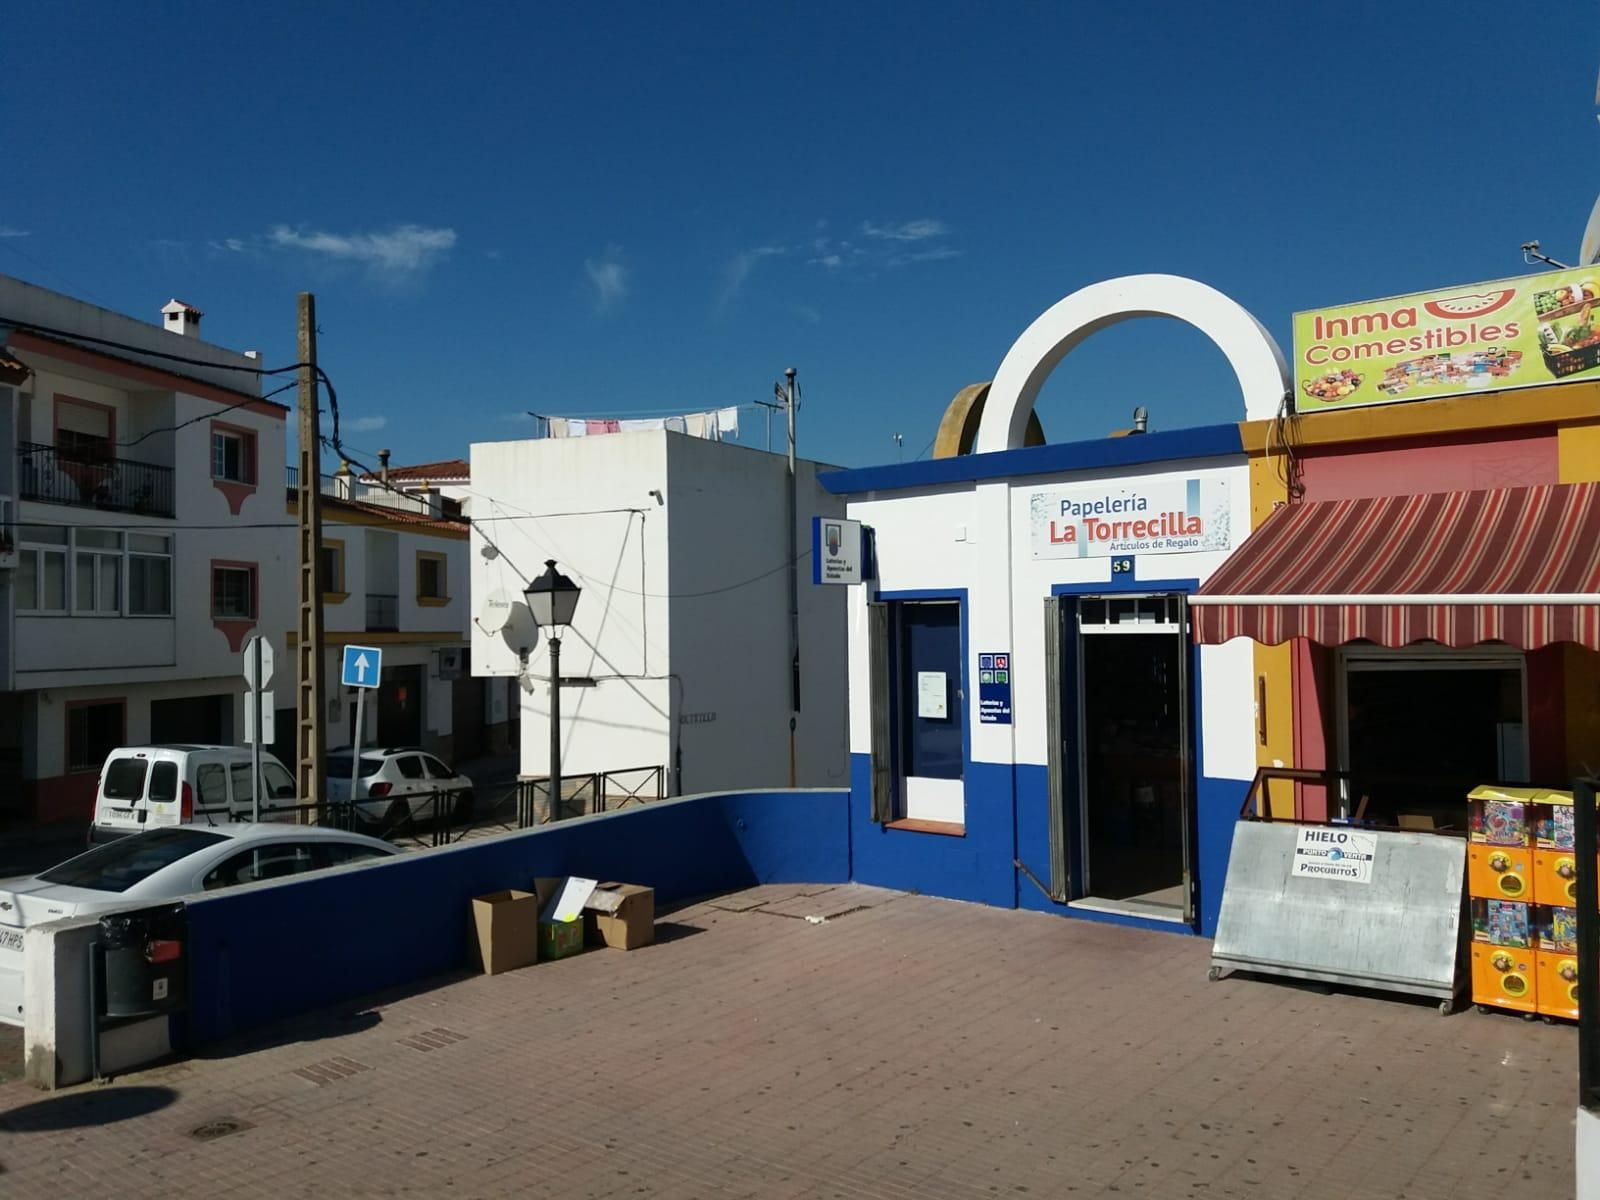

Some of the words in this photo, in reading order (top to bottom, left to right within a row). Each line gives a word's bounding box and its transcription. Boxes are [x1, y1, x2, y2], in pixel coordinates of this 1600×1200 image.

[1314, 307, 1417, 341] Inma
[1305, 321, 1520, 365] Comestibles
[1060, 493, 1147, 518] Papelería
[1050, 521, 1076, 544] La
[1082, 511, 1202, 543] Torrecilla
[1152, 540, 1164, 549] de
[1166, 537, 1199, 550] Regalo
[1113, 560, 1130, 572] 59
[1305, 831, 1348, 843] HIELO
[1303, 848, 1327, 857] PUNTO
